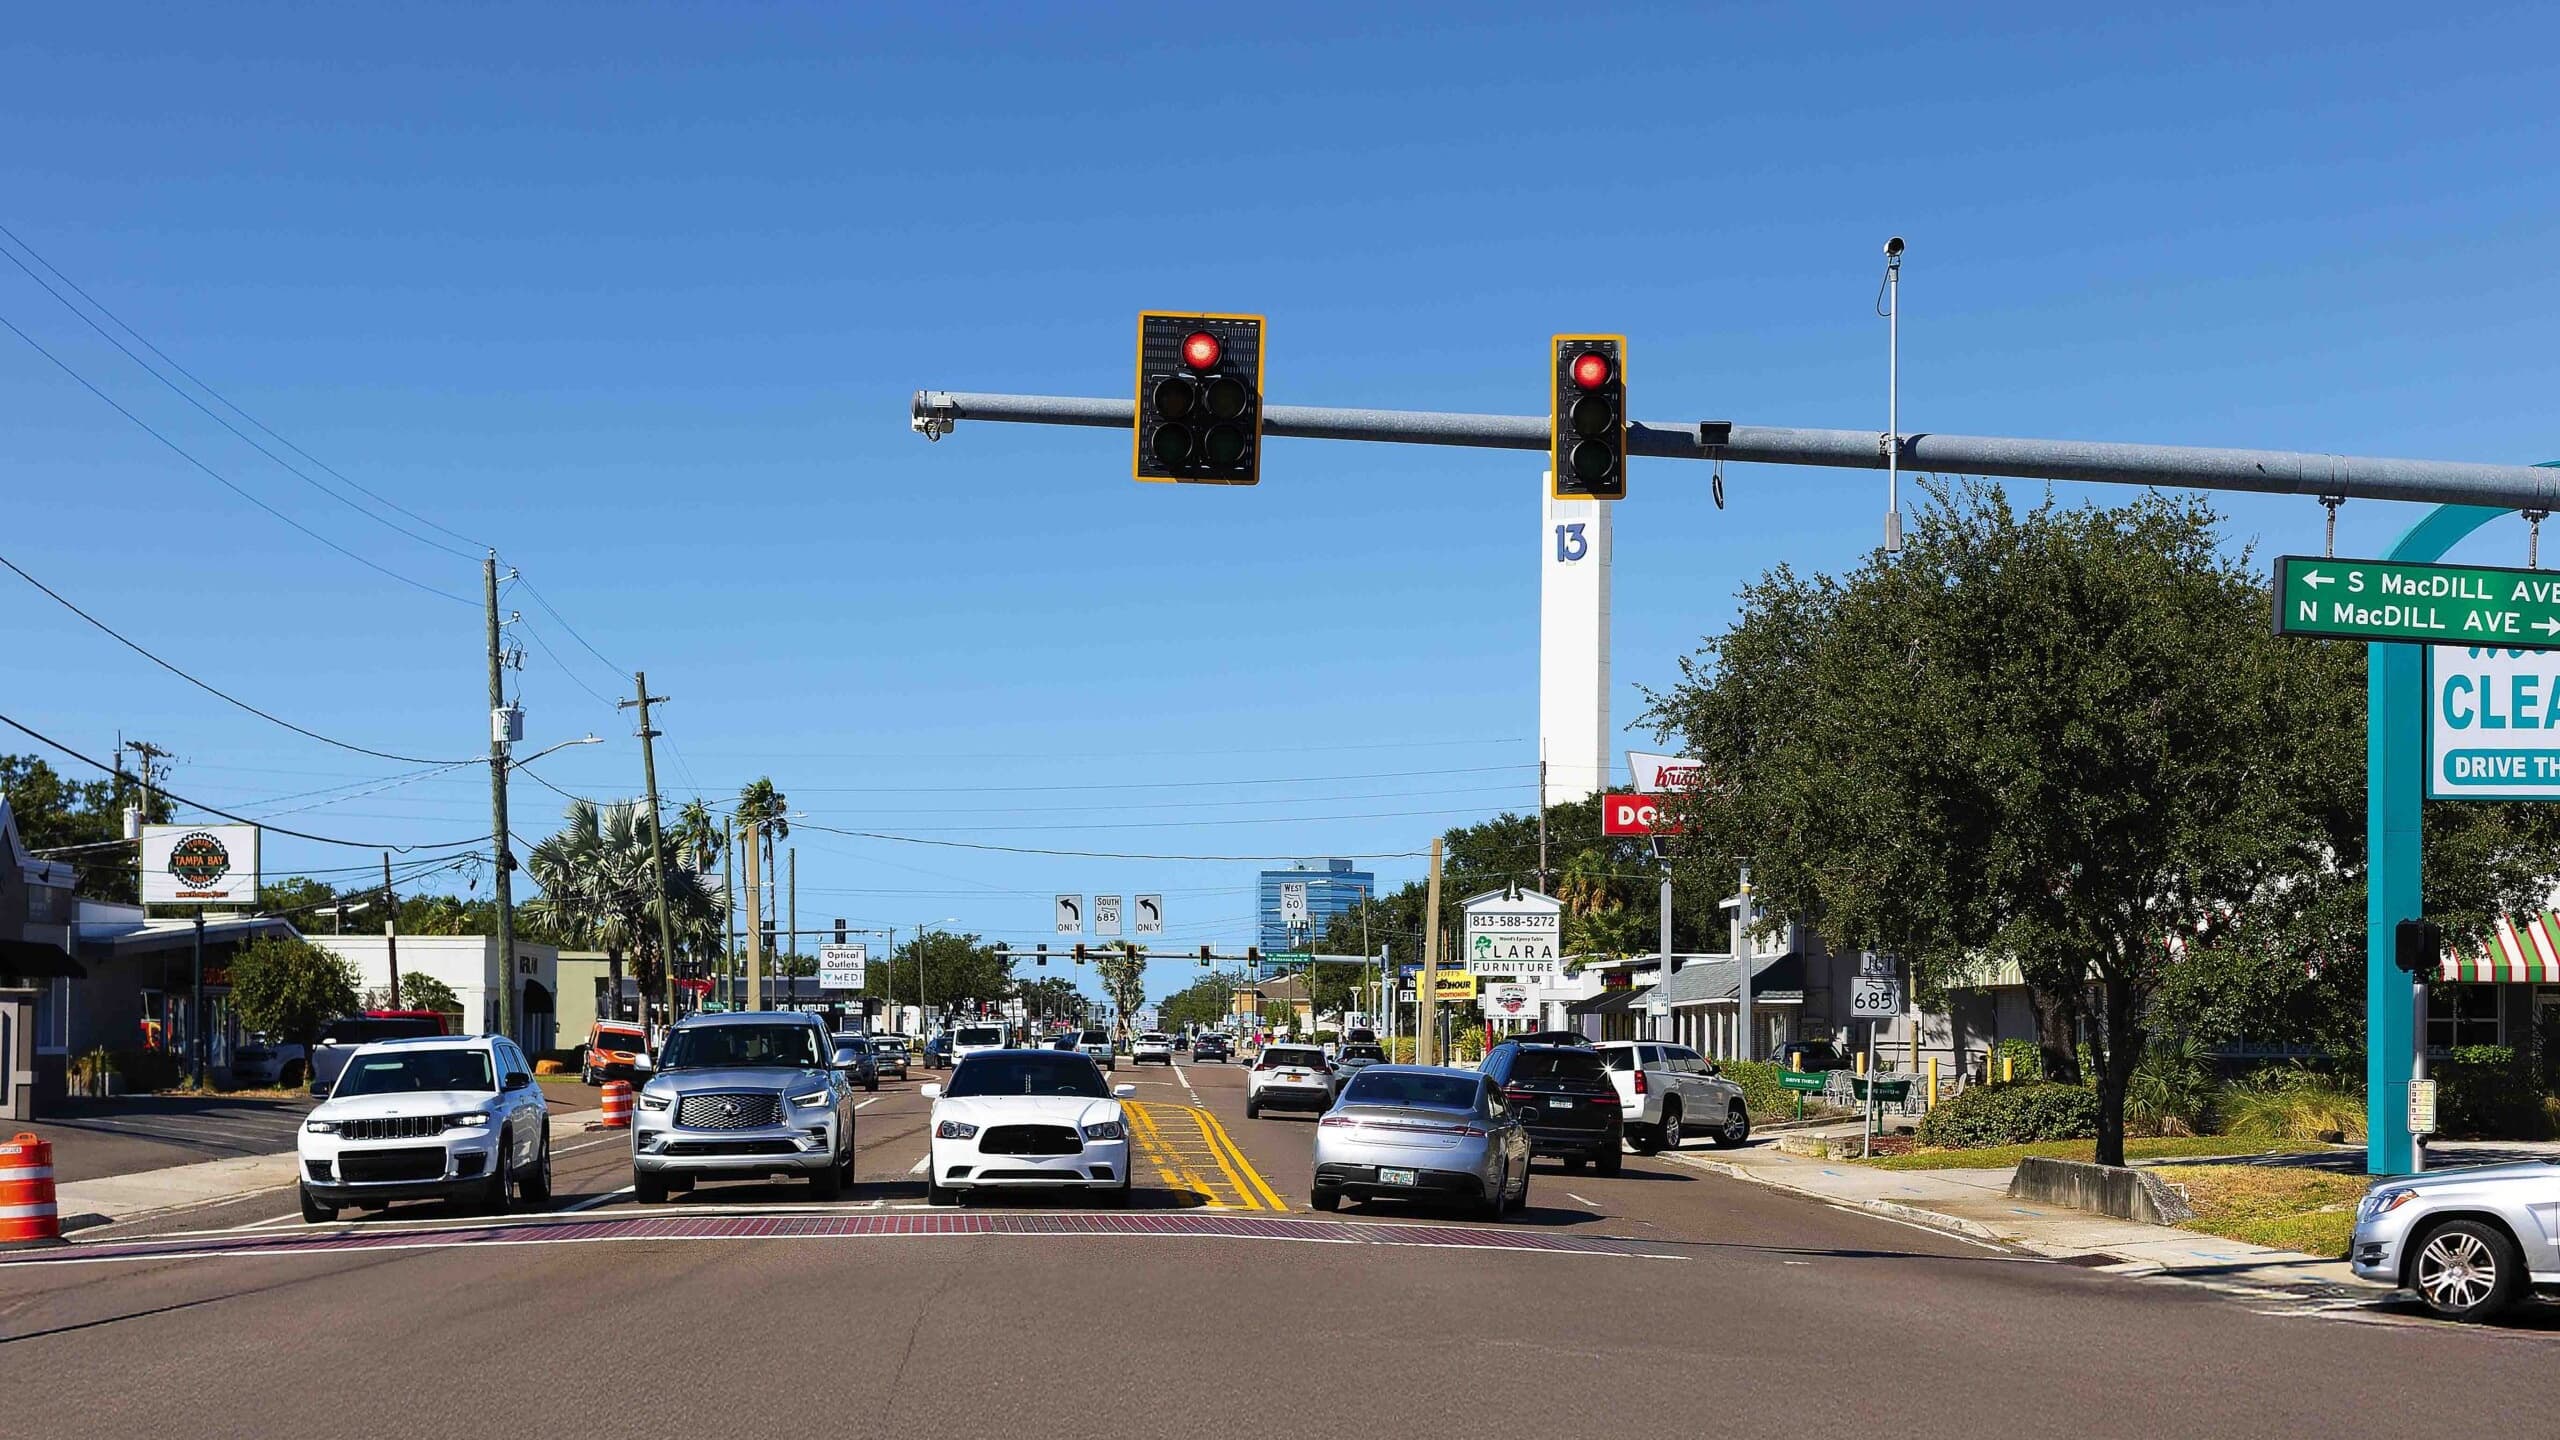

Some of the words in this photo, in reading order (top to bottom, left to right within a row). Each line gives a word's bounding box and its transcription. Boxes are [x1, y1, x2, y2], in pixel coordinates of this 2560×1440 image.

[1555, 523, 1588, 562] 13
[2347, 571, 2365, 593] S
[2381, 573, 2494, 600] MacDILL
[2299, 600, 2318, 622] N
[2333, 602, 2446, 629] MacDILL
[2463, 610, 2521, 634] AVE
[2455, 756, 2527, 778] DRIVE
[174, 855, 204, 866] TAMPA
[207, 855, 225, 865] BAY
[1284, 884, 1302, 892] WEST
[1286, 900, 1300, 909] 60
[1096, 913, 1116, 921] 685
[1472, 916, 1555, 927] 813-588-5272
[827, 951, 859, 960] Optical
[1493, 945, 1553, 958] LARA
[827, 960, 859, 968] Outlets
[1473, 963, 1553, 972] FURNITURE
[834, 973, 862, 981] MEDI
[1449, 981, 1471, 989] HOUR
[1854, 992, 1893, 1010] 685
